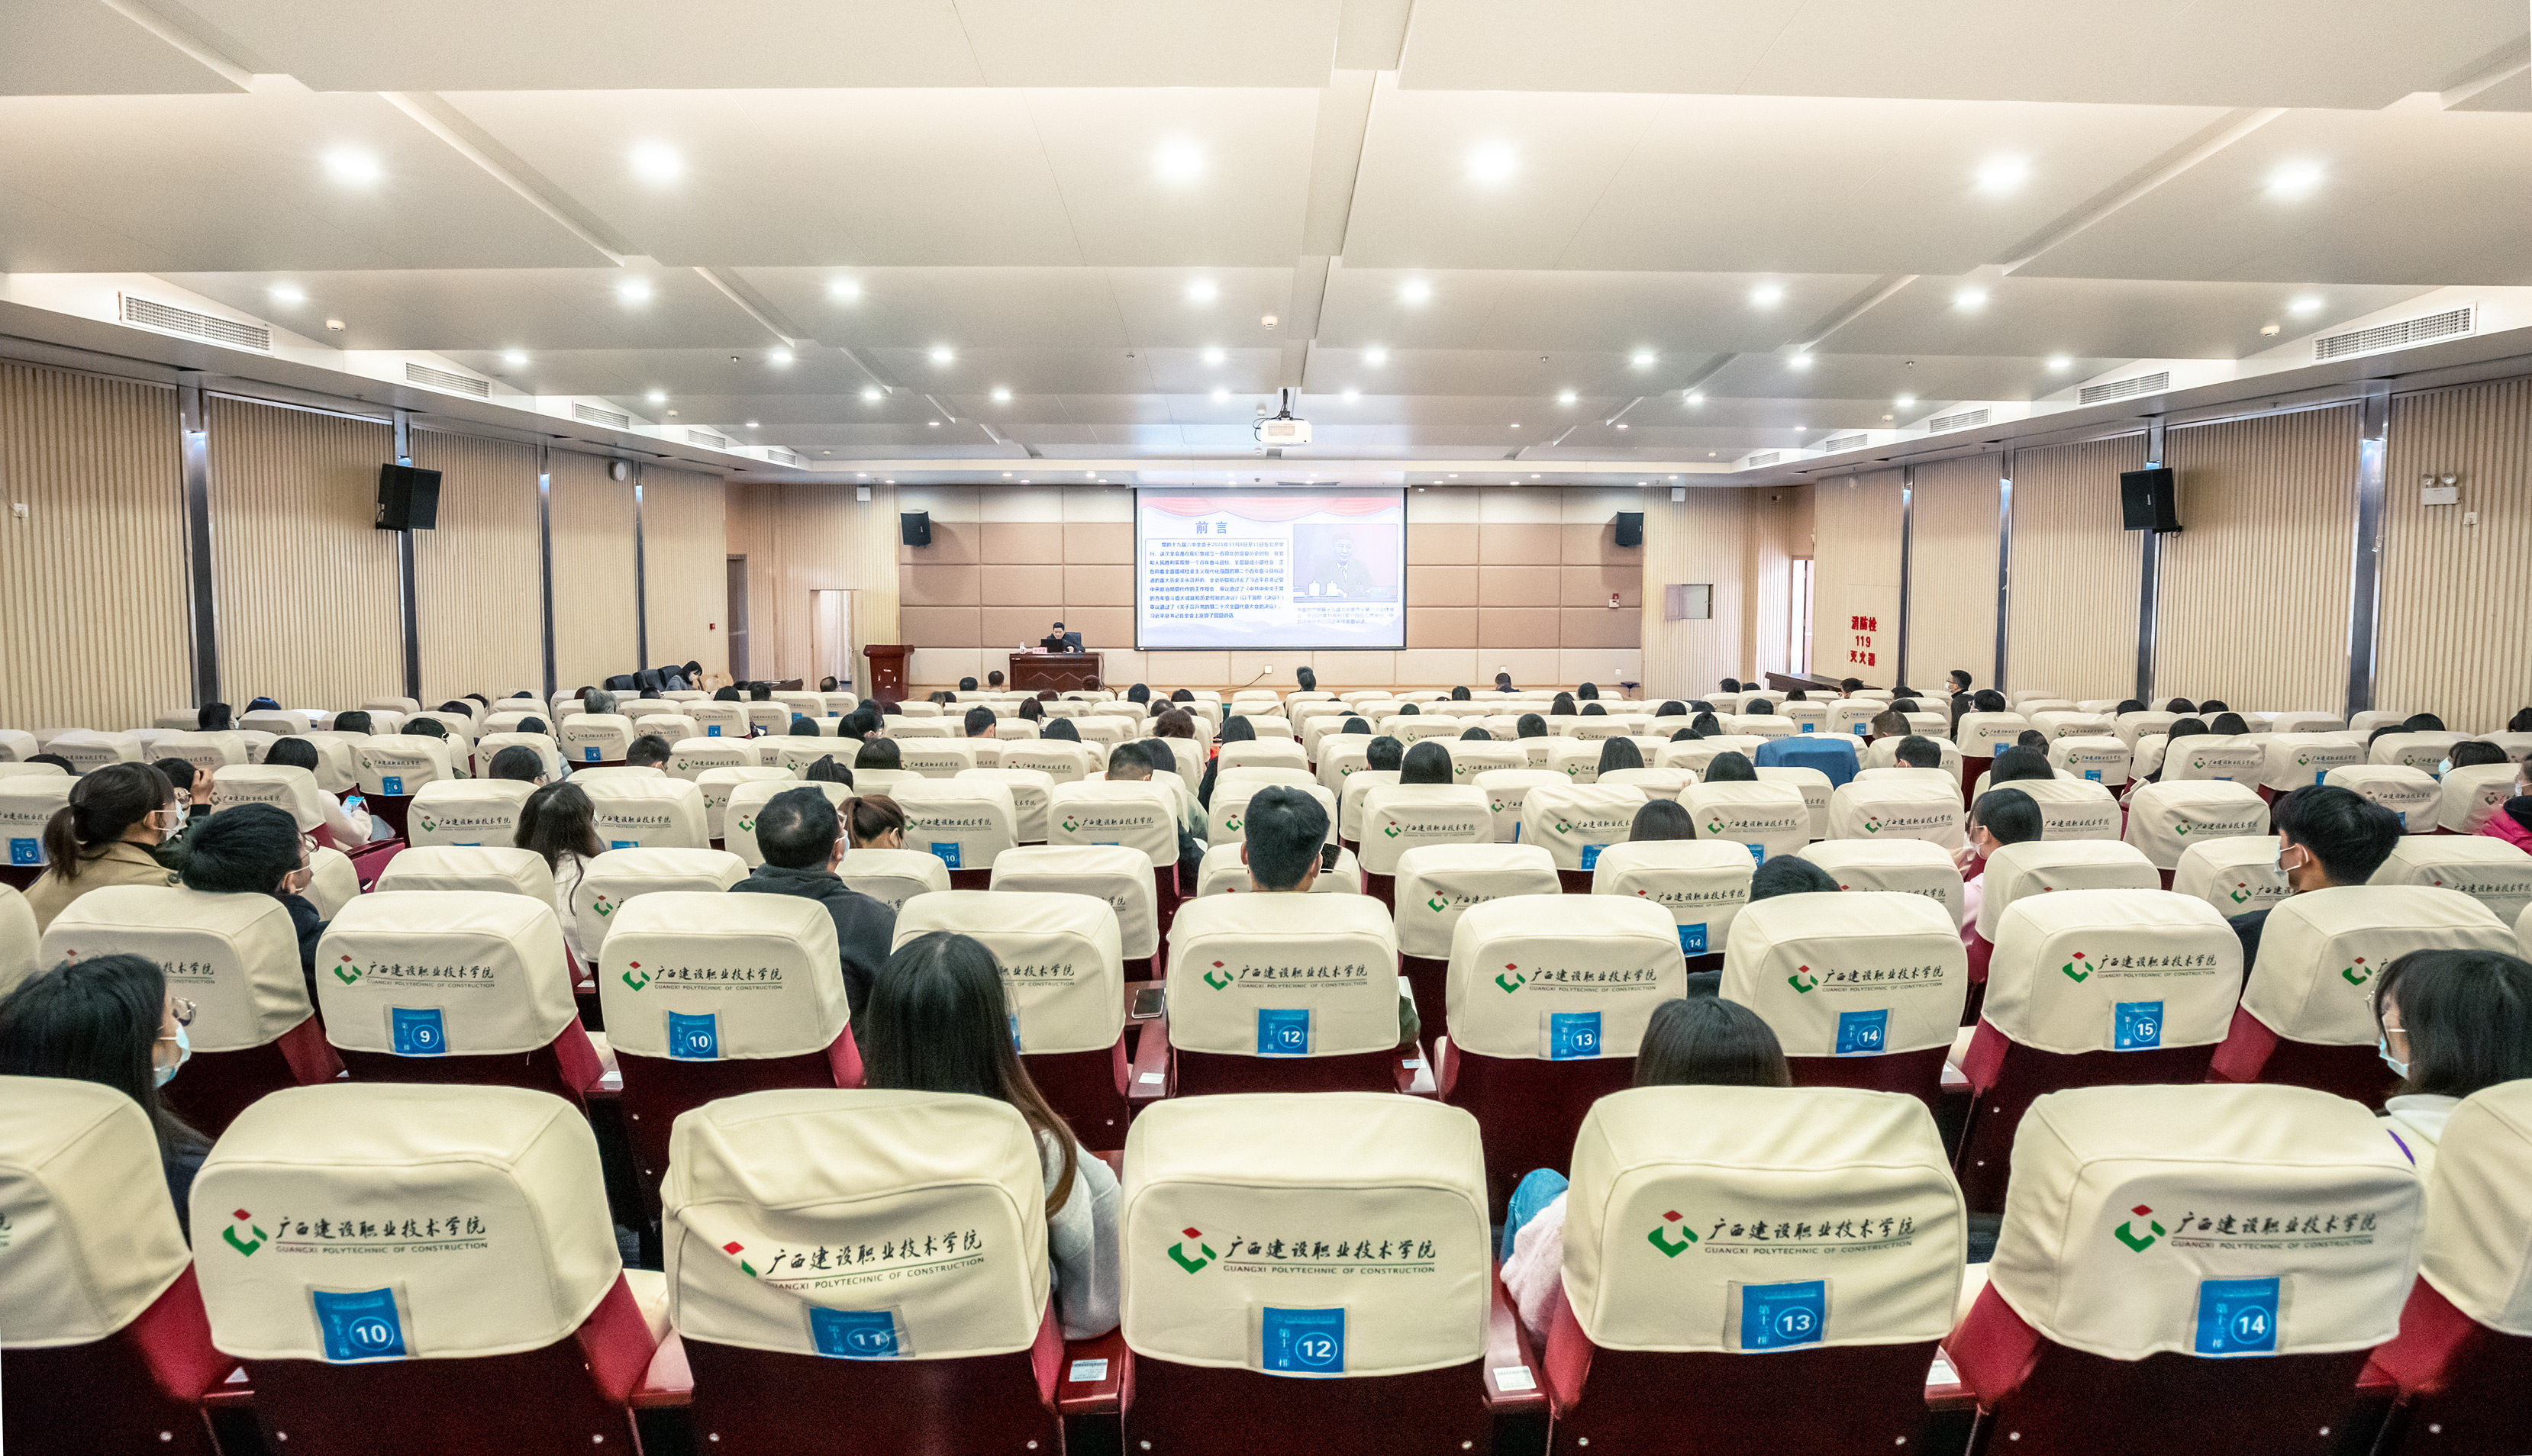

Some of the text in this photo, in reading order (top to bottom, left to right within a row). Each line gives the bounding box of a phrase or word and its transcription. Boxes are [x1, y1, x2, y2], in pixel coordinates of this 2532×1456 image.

[1195, 520, 1227, 534] 前言
[1851, 616, 1877, 632] 消防栓
[1856, 635, 1871, 648] 119
[1850, 650, 1876, 667] 灭火器
[1656, 889, 1745, 902] 广西建设职业技术学院
[1689, 939, 1701, 948] 14
[367, 962, 494, 978] 广西建设职业技术学院
[2098, 955, 2217, 970] 广西建设职业技术学院
[655, 965, 782, 981] 广西建设职业技术学院
[1238, 965, 1367, 980] 广西建设职业技术学院
[1530, 967, 1656, 982] 广西建设职业技术学院
[1824, 965, 1943, 984] 广西建设职业技术学院
[420, 1030, 430, 1043] 9
[1282, 1031, 1300, 1042] 12
[1863, 1030, 1878, 1042] 14
[2137, 1023, 2153, 1036] 15
[690, 1036, 708, 1048] 10
[1576, 1033, 1593, 1046] 13
[276, 1216, 485, 1239] 广西建设职业技术学院
[1707, 1217, 1915, 1241] 广西建设职业技术学院
[2174, 1212, 2377, 1235] 广西建设职业技术学院
[276, 1245, 318, 1254] GUANGXI
[411, 1242, 488, 1252] CONSTRUCTION
[765, 1229, 982, 1275] 广西建设职业技术学院
[1224, 1235, 1436, 1260] 广西建设职业技术学院
[1841, 1240, 1912, 1253] CONSTRUCTION
[770, 1257, 985, 1291] UANGXI POLYTECHNIC OF CONSTRUCTION
[1782, 1315, 1810, 1332] 13
[2239, 1315, 2265, 1335] 14
[356, 1325, 387, 1343] 10
[854, 1334, 882, 1345] 11
[1302, 1341, 1331, 1357] 12
